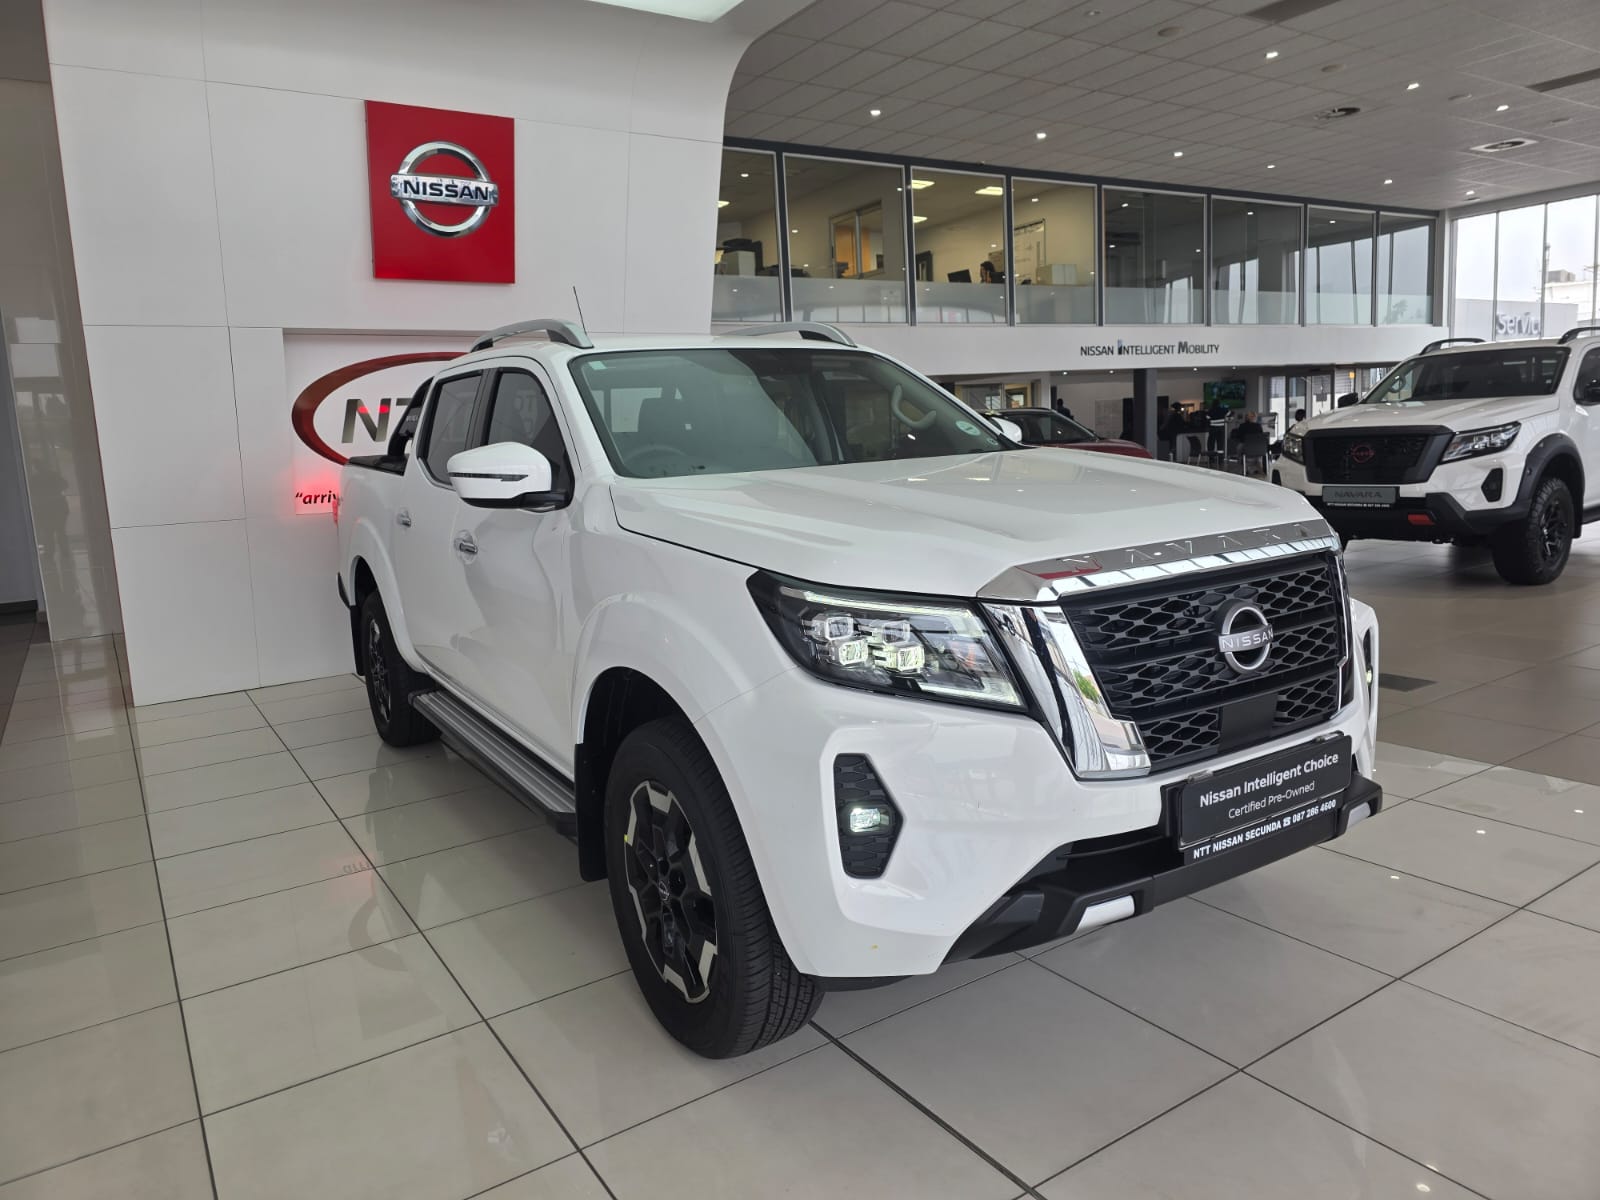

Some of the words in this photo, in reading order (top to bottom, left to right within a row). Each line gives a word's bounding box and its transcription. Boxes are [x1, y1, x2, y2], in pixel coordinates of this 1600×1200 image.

[402, 180, 489, 201] NISSAN
[1080, 345, 1114, 356] NISSAN
[1117, 339, 1175, 356] INTELLIGENT
[1178, 341, 1220, 355] MOBILITY
[1222, 627, 1274, 649] NISSAN
[1200, 785, 1242, 808] Nissan
[1243, 764, 1302, 794] Intelligent
[1303, 753, 1340, 774] Choice
[1228, 797, 1267, 819] Certified
[1268, 781, 1316, 806] Pre-Owned
[1193, 844, 1211, 859] NTT
[1212, 833, 1244, 853] NISSAN
[1245, 821, 1282, 841] SECUNDA
[1292, 811, 1306, 824] 087
[1306, 806, 1319, 818] 286
